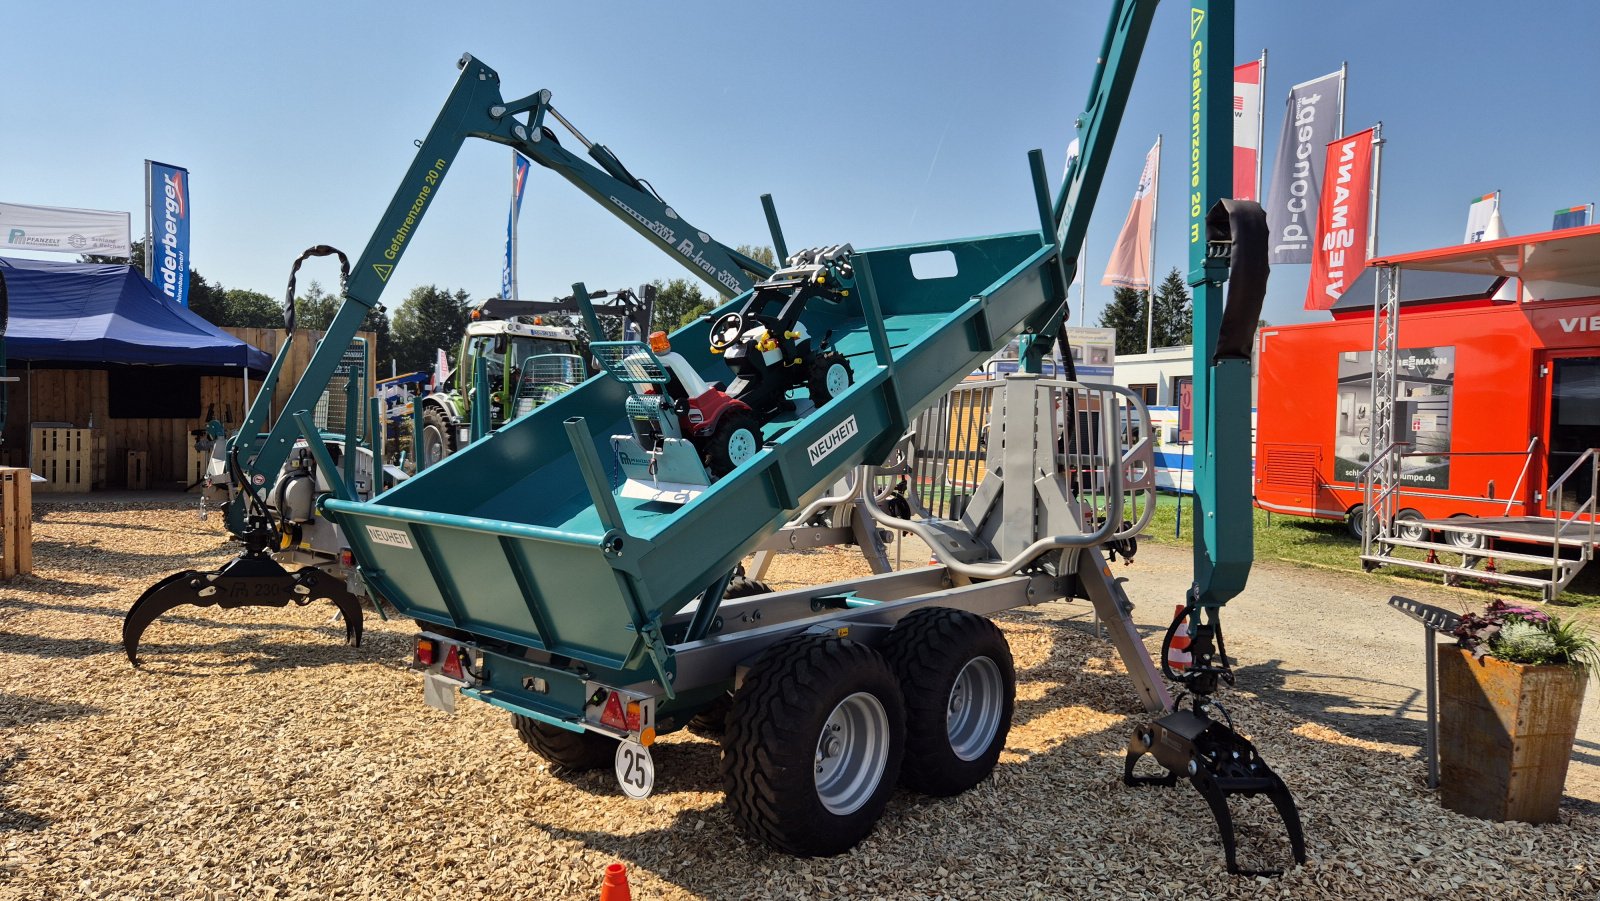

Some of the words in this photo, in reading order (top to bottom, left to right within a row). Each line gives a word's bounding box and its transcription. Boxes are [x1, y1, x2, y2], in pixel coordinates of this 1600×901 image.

[1191, 40, 1202, 188] Gefahrenzone
[384, 185, 431, 260] Gefahrenzone
[425, 169, 439, 186] 20
[434, 158, 446, 171] m
[1191, 191, 1201, 218] 20
[1191, 223, 1200, 243] m
[810, 418, 855, 462] NEUHEIT
[369, 528, 409, 545] NEUHEIT
[623, 748, 646, 790] 25
